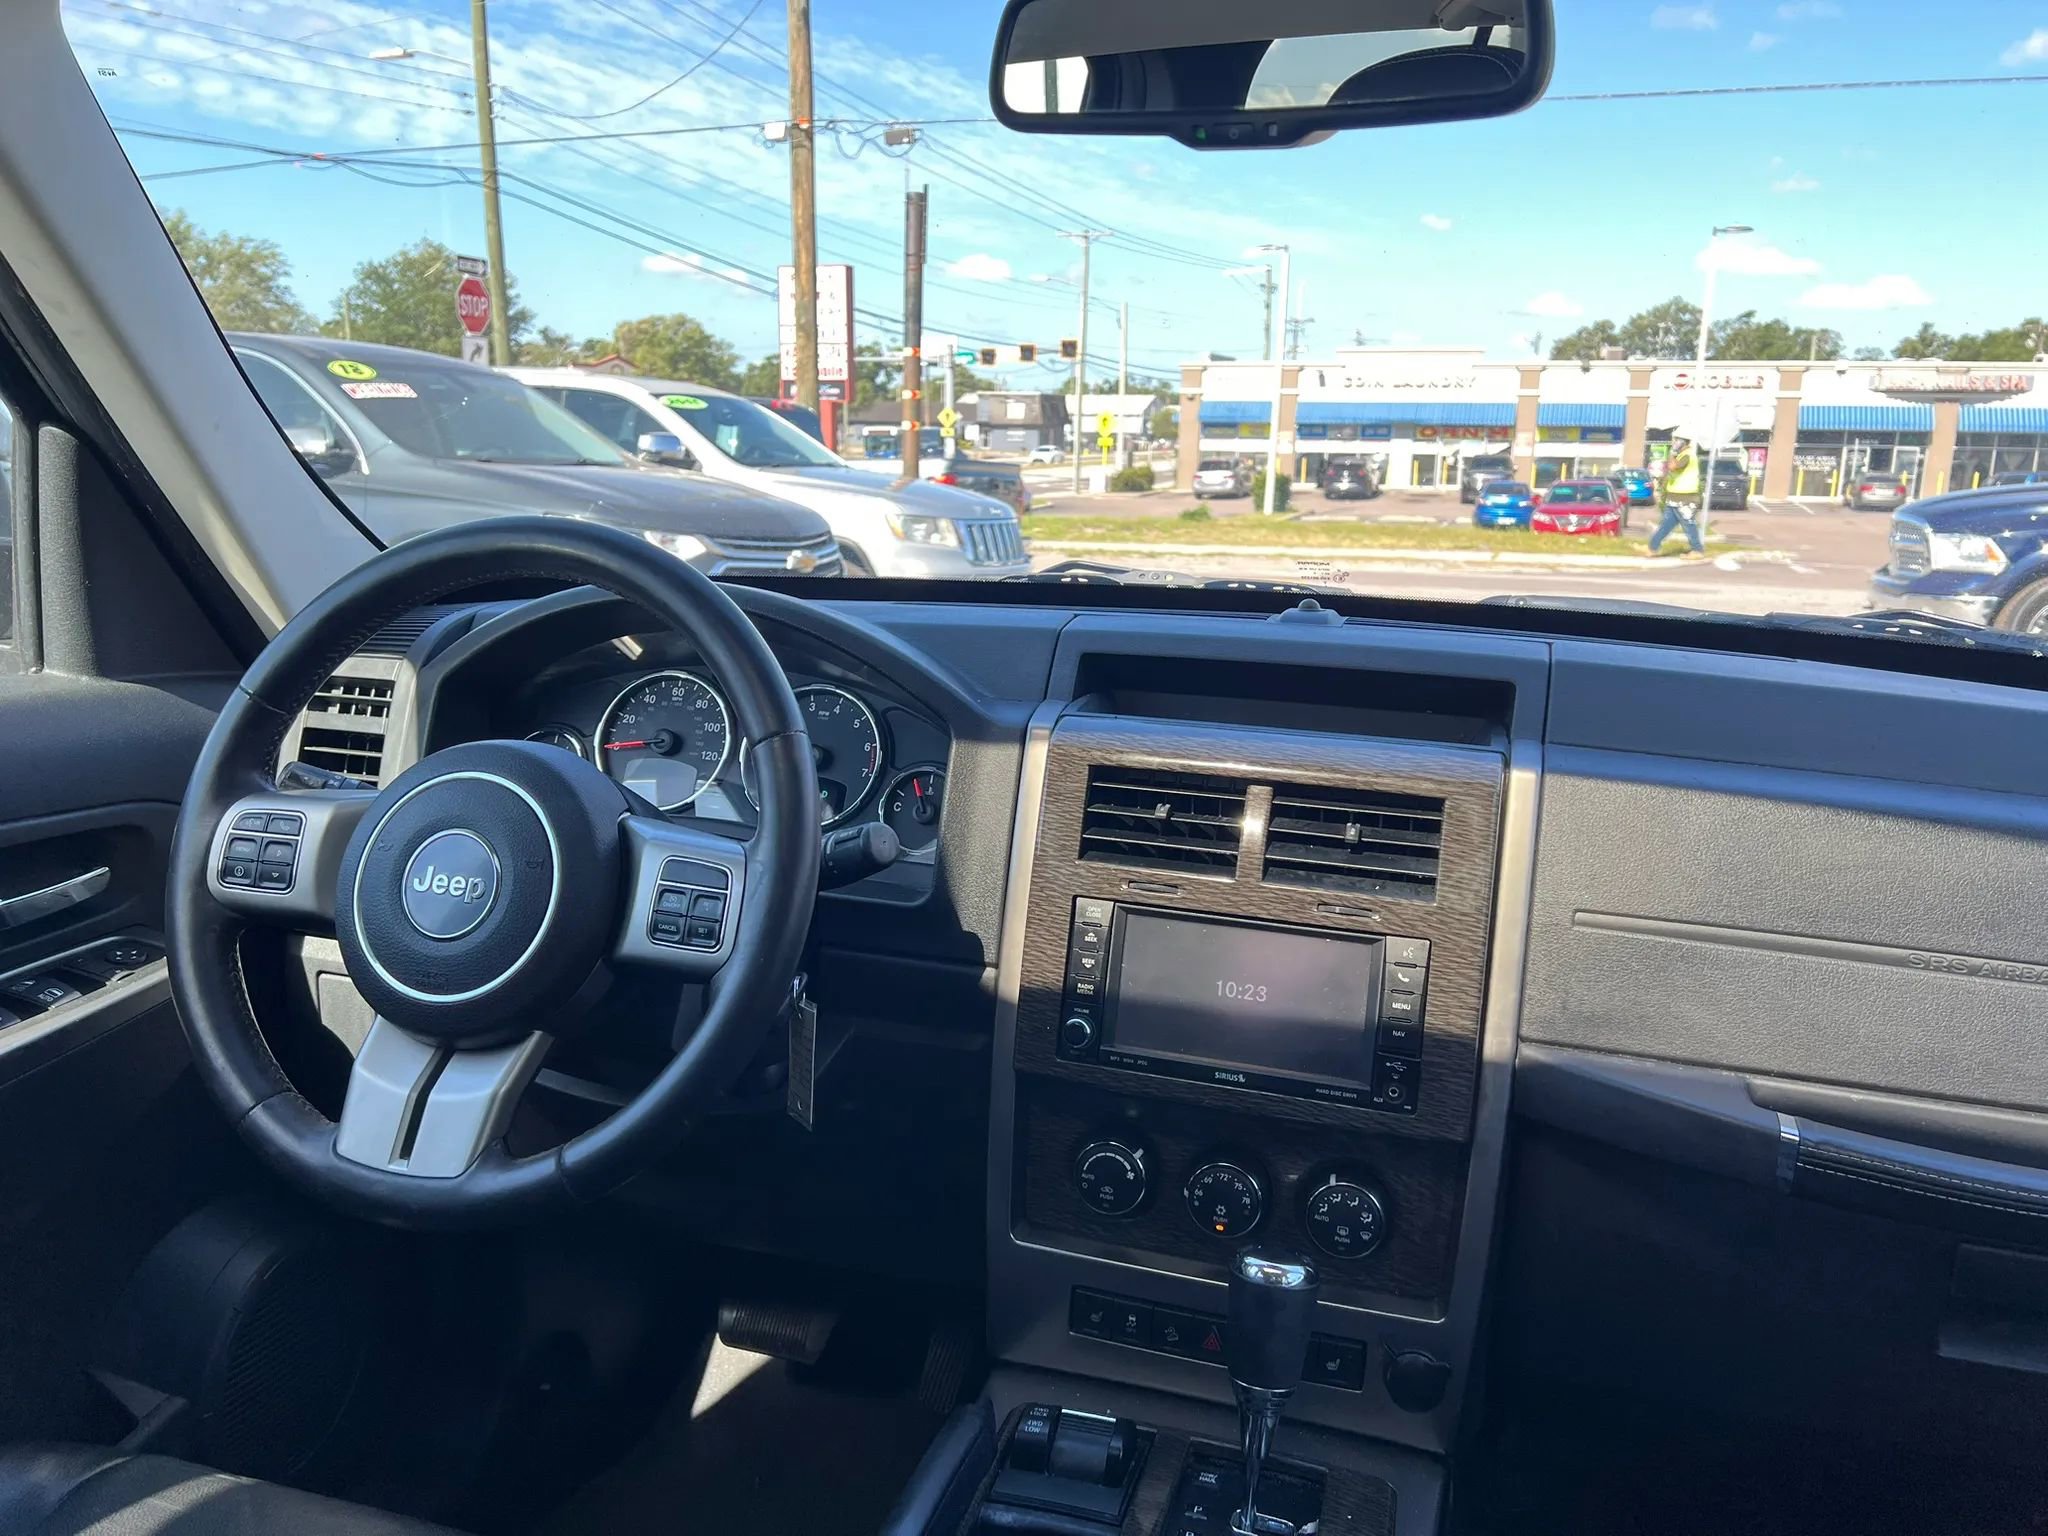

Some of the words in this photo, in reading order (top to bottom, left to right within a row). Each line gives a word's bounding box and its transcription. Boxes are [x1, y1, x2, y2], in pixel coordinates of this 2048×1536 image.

[460, 294, 488, 317] STOP
[672, 687, 684, 697] 60
[644, 694, 656, 704] 40
[695, 700, 708, 709] 80
[809, 702, 816, 712] 3
[833, 705, 841, 714] 4
[622, 714, 636, 724] 20
[853, 719, 860, 728] 5
[704, 722, 720, 732] 100
[864, 742, 871, 751] 6
[701, 751, 718, 761] 120
[861, 768, 868, 777] 7
[821, 790, 828, 798] D
[893, 802, 902, 811] C
[413, 865, 487, 904] Jeep
[658, 923, 678, 932] CANCEL
[1082, 958, 1096, 966] SEEK
[1908, 952, 1969, 974] SRS
[1216, 980, 1267, 1001] 10:23
[1392, 1002, 1411, 1010] MENU
[1214, 1071, 1239, 1081] SIRIUS
[1203, 1176, 1213, 1184] 69
[1219, 1173, 1229, 1182] 72
[1234, 1182, 1243, 1191] 75
[1194, 1188, 1203, 1197] 66
[1241, 1197, 1250, 1205] 78
[1314, 1214, 1330, 1222] AUTO
[1335, 1236, 1350, 1244] PUSH
[1194, 1505, 1203, 1513] P
